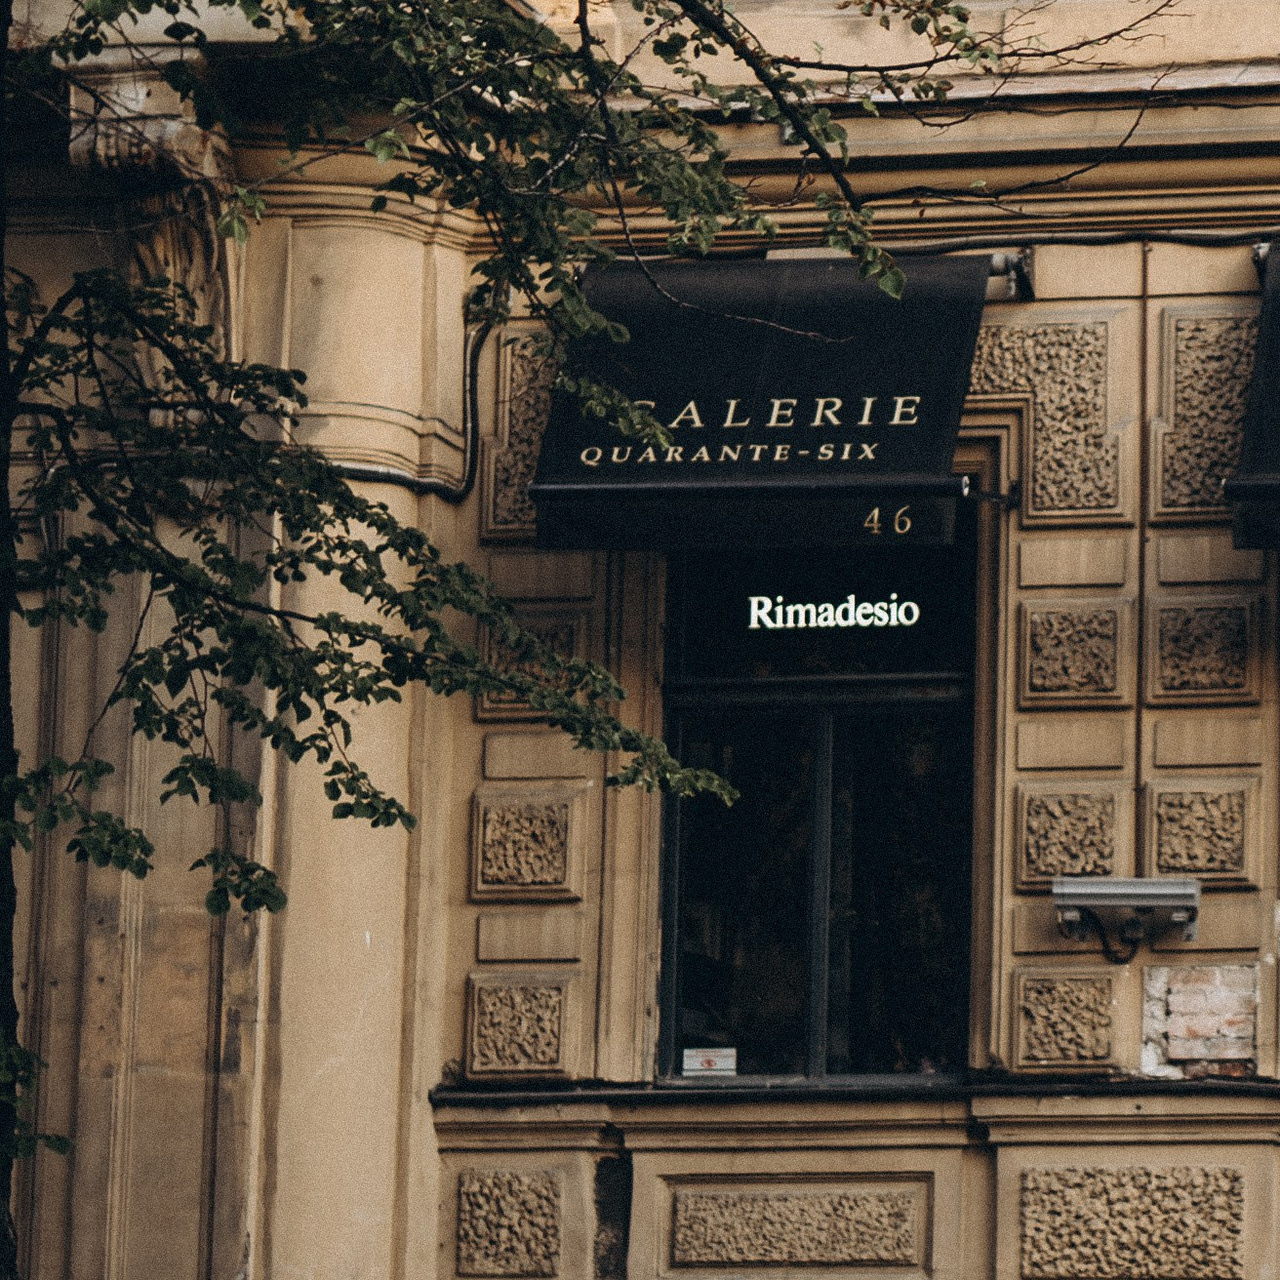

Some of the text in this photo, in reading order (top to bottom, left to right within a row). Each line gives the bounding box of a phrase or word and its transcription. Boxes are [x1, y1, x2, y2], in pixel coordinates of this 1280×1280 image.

[580, 442, 879, 466] QUARANTE-SIX
[863, 504, 913, 534] 46
[747, 592, 921, 630] Rimadesio
